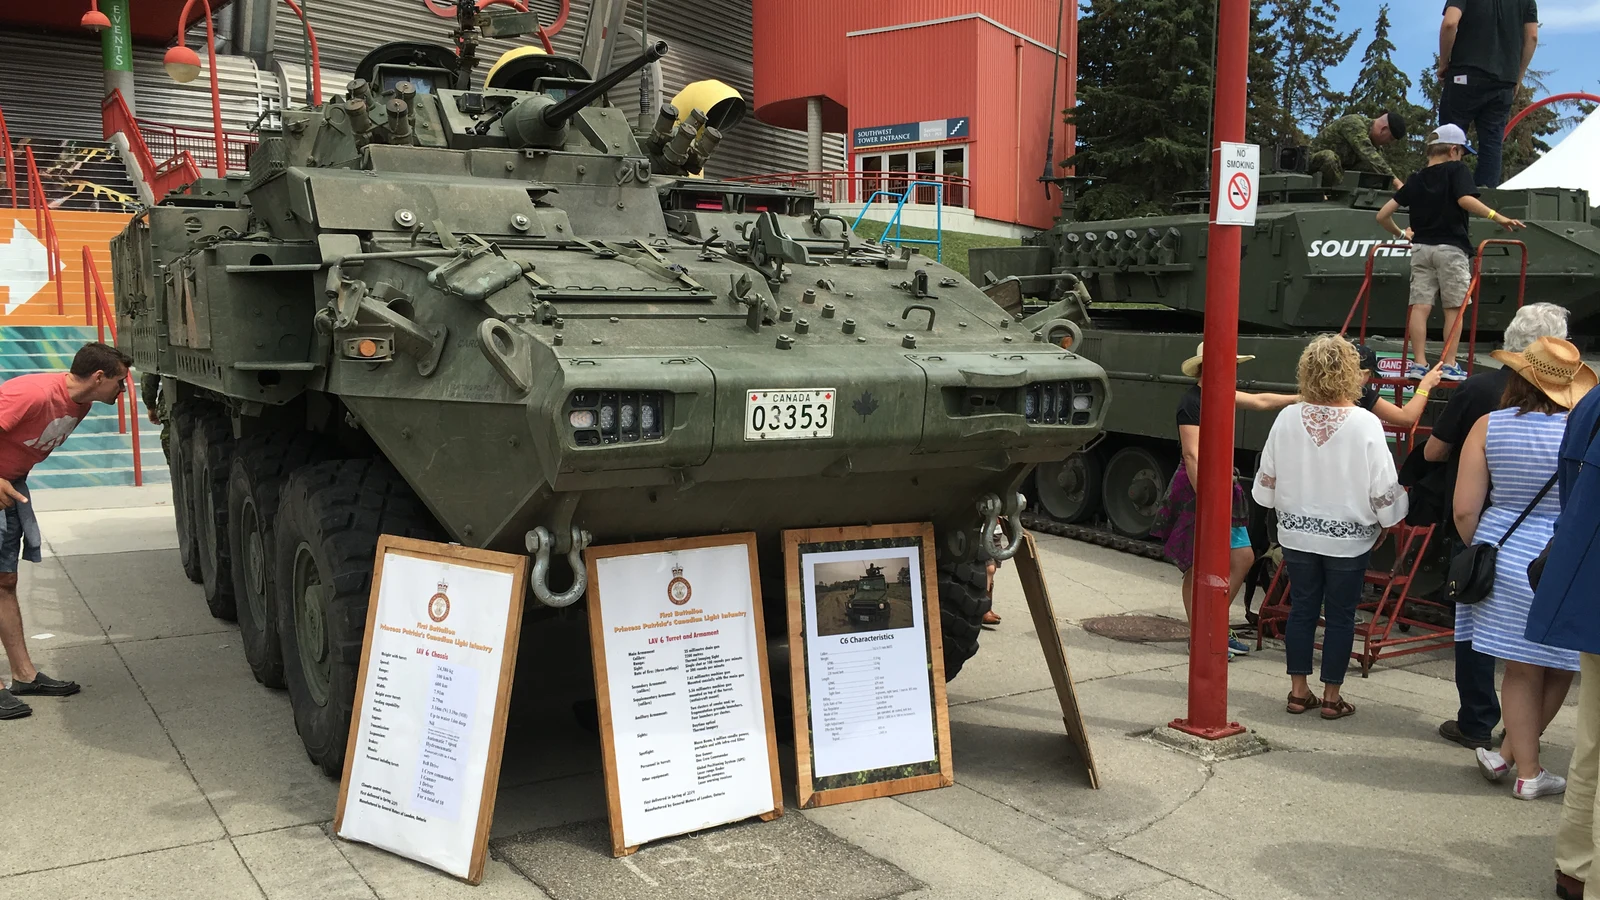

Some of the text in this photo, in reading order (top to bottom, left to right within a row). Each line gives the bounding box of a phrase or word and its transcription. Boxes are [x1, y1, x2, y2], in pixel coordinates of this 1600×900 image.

[114, 5, 123, 66] EVENTS
[858, 128, 892, 138] SOUTHWEST
[880, 133, 910, 142] ENTRANCE
[1227, 160, 1254, 169] SMOKING
[1307, 240, 1412, 257] SOUTHE
[1380, 361, 1412, 369] DANGR
[773, 393, 811, 402] CANADA
[753, 404, 827, 431] 03353
[674, 608, 703, 617] Battalion
[642, 620, 672, 629] Patricia's
[673, 617, 703, 625] Canadian
[429, 625, 455, 635] Battalion
[694, 629, 719, 638] Armament
[380, 623, 401, 633] Princess
[426, 633, 453, 644] Canadian
[454, 639, 468, 648] Light
[469, 642, 493, 653] Infantry
[850, 633, 894, 643] Characteristics
[431, 651, 448, 660] Chassis
